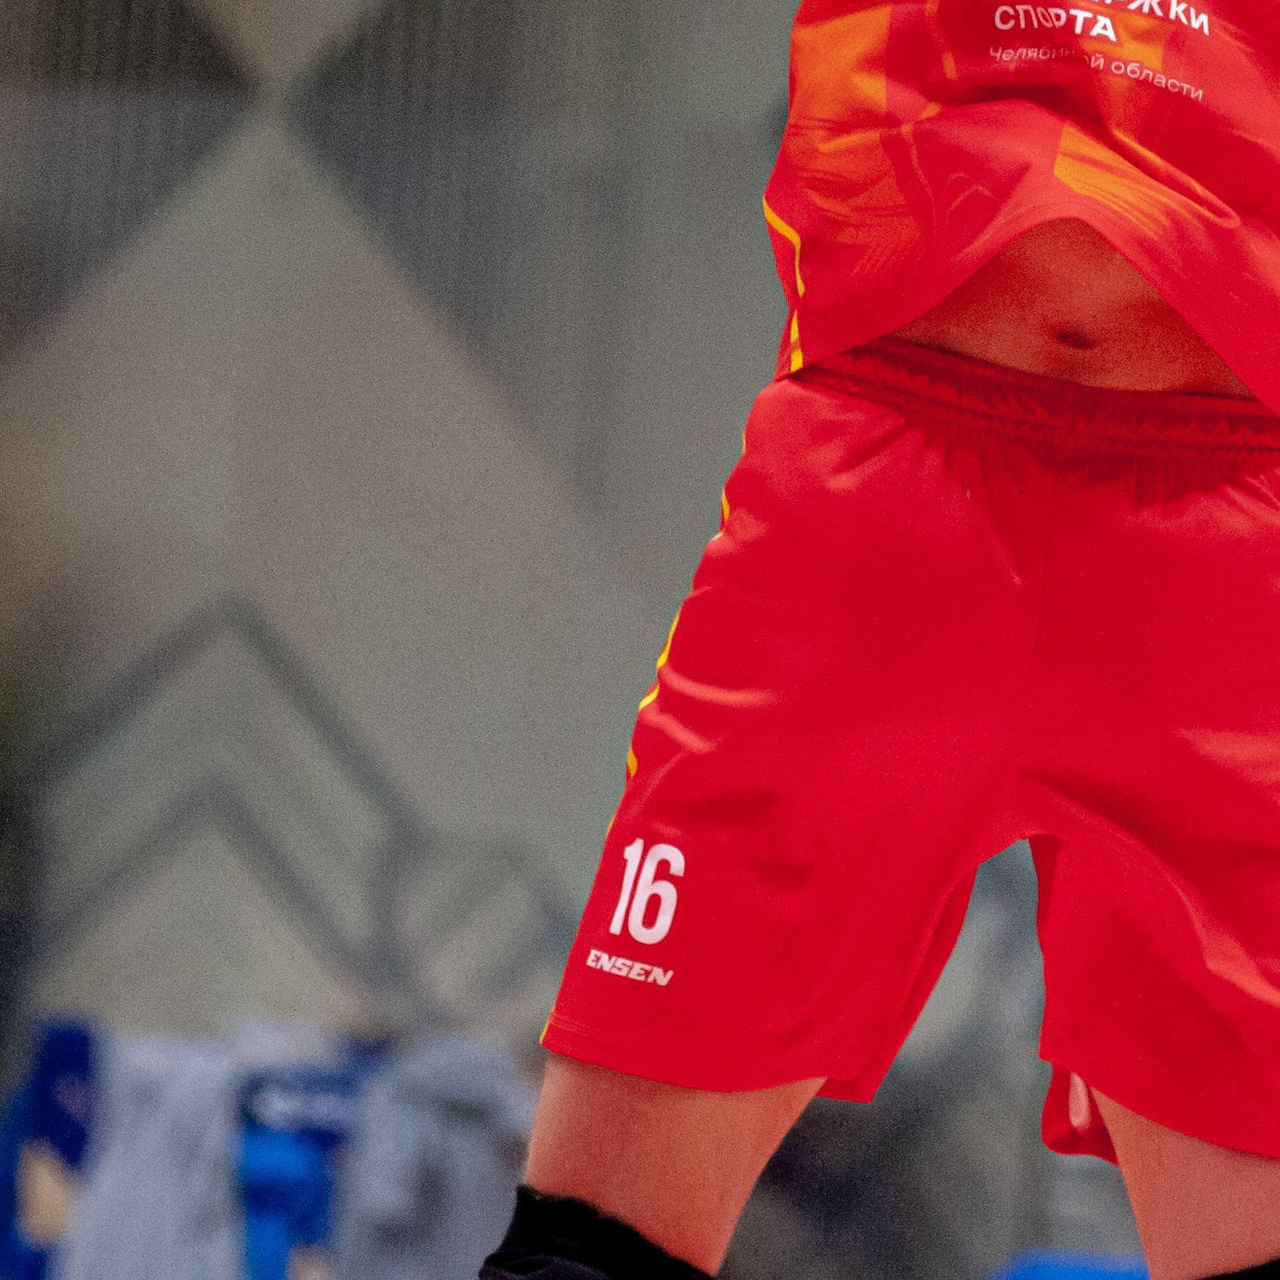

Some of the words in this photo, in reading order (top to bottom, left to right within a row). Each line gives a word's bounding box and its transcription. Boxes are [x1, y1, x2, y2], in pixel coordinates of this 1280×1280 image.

[993, 4, 1118, 43] СПОРТА
[1110, 60, 1205, 102] области
[608, 837, 686, 946] 16
[585, 948, 675, 987] ENSEN
